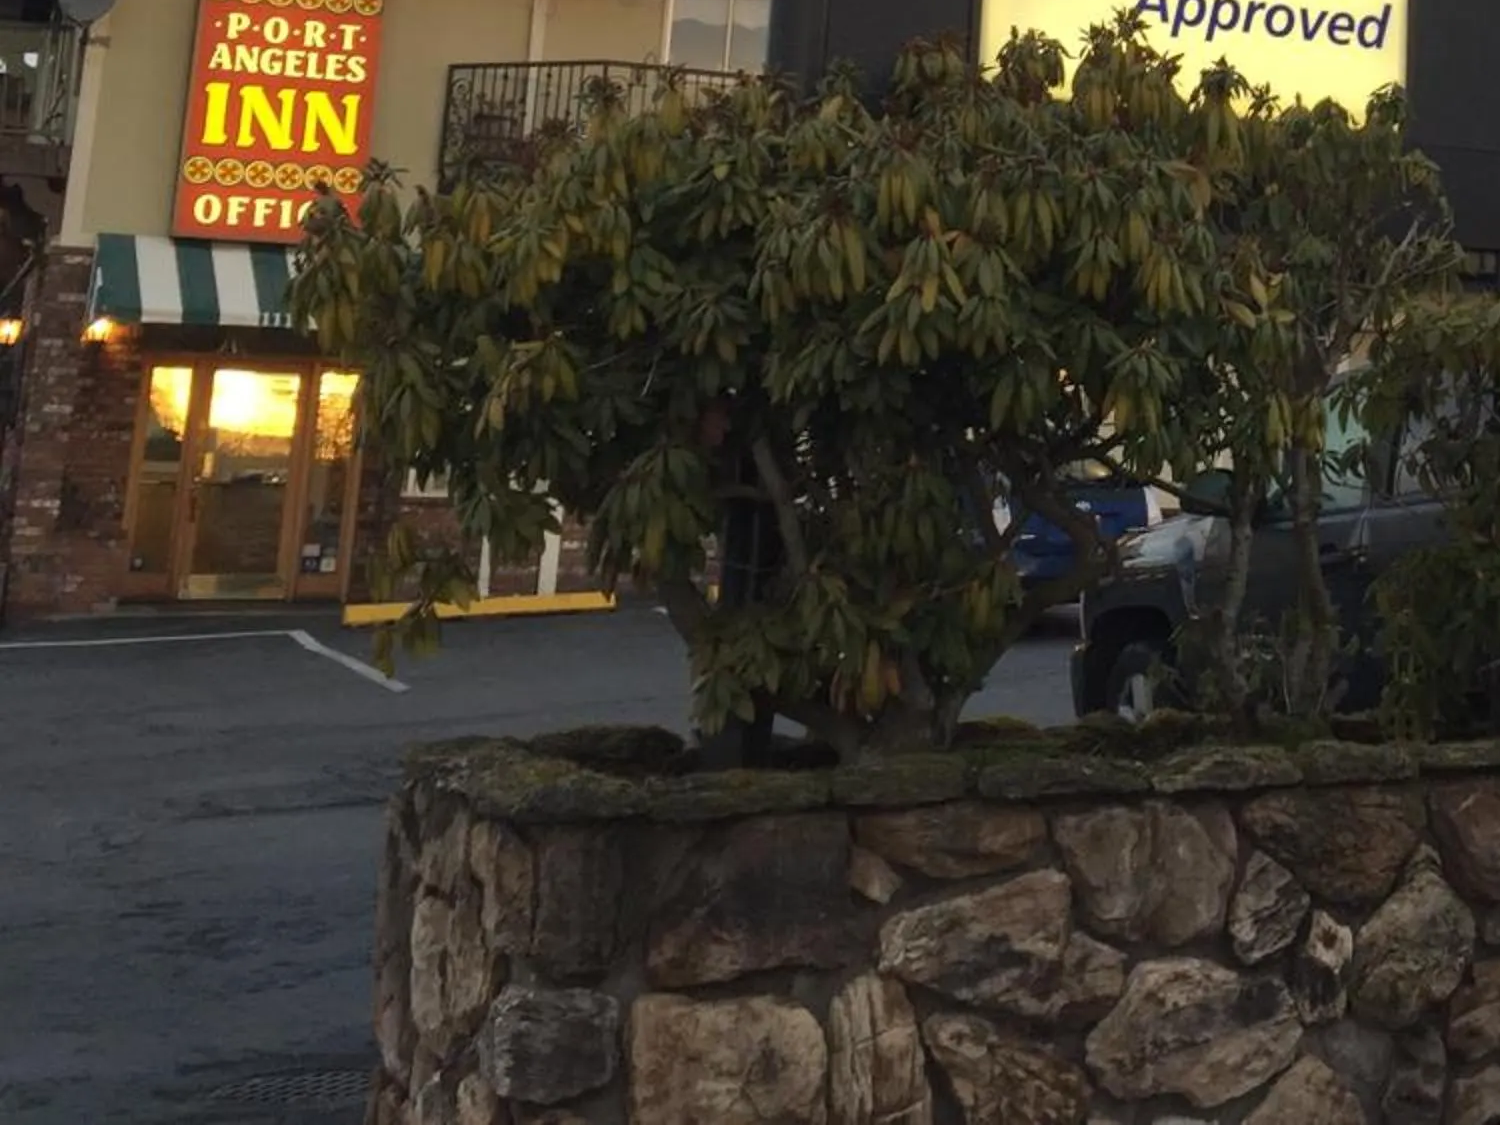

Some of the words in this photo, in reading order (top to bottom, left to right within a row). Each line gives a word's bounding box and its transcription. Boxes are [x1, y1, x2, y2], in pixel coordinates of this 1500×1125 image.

[208, 42, 367, 83] ANGELES
[201, 81, 361, 155] INN
[193, 193, 313, 229] OFFI
